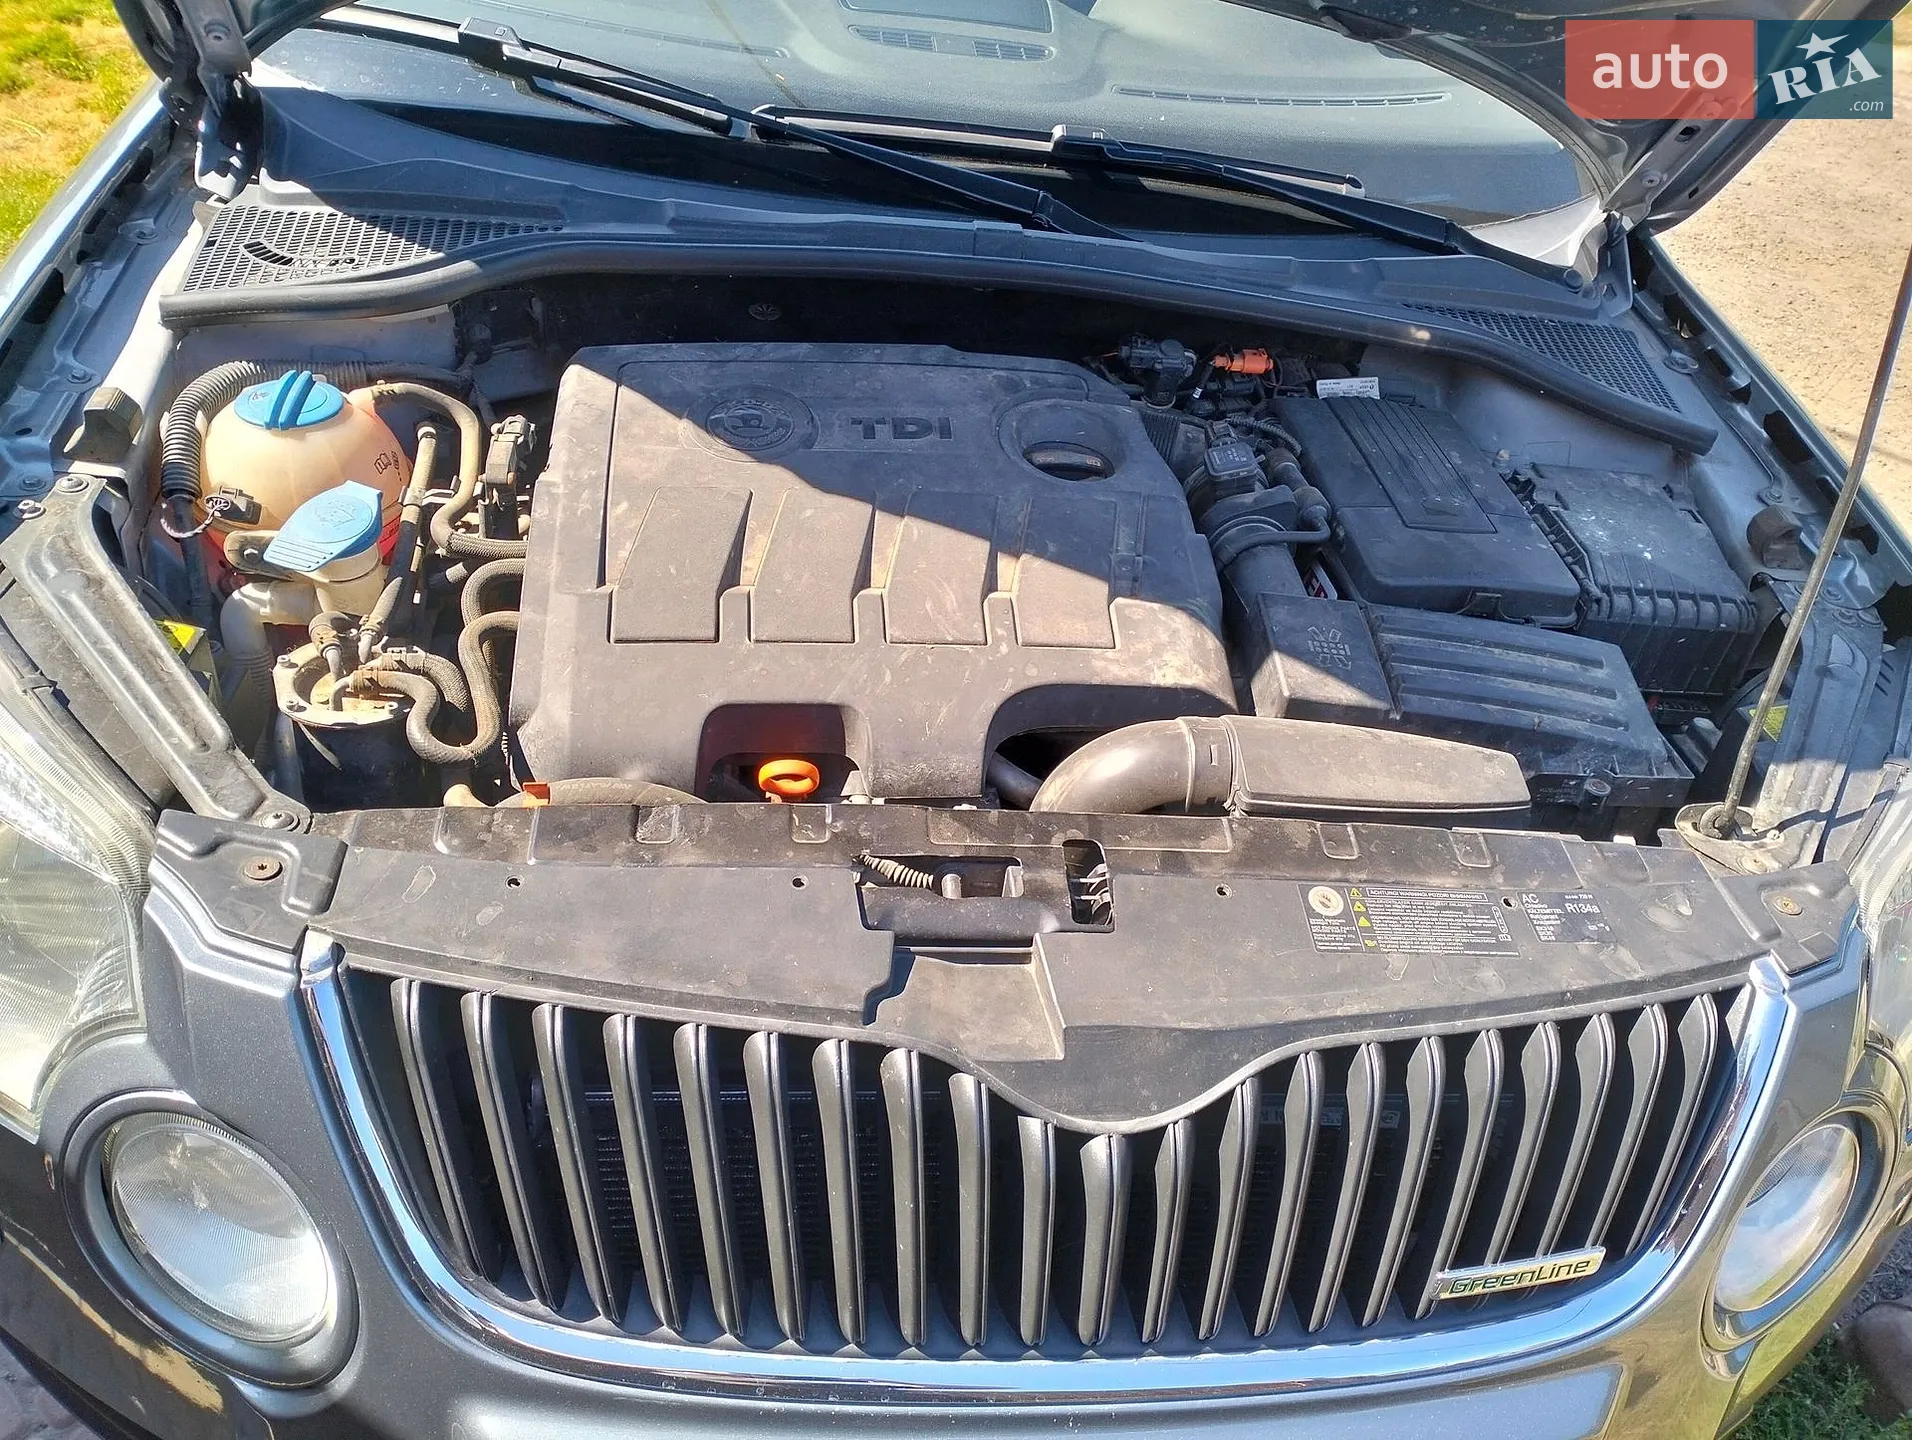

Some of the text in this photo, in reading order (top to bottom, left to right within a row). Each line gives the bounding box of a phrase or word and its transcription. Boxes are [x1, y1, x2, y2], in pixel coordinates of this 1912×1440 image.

[850, 416, 953, 440] TDI
[1522, 893, 1539, 904] AC
[1565, 902, 1601, 914] R134a
